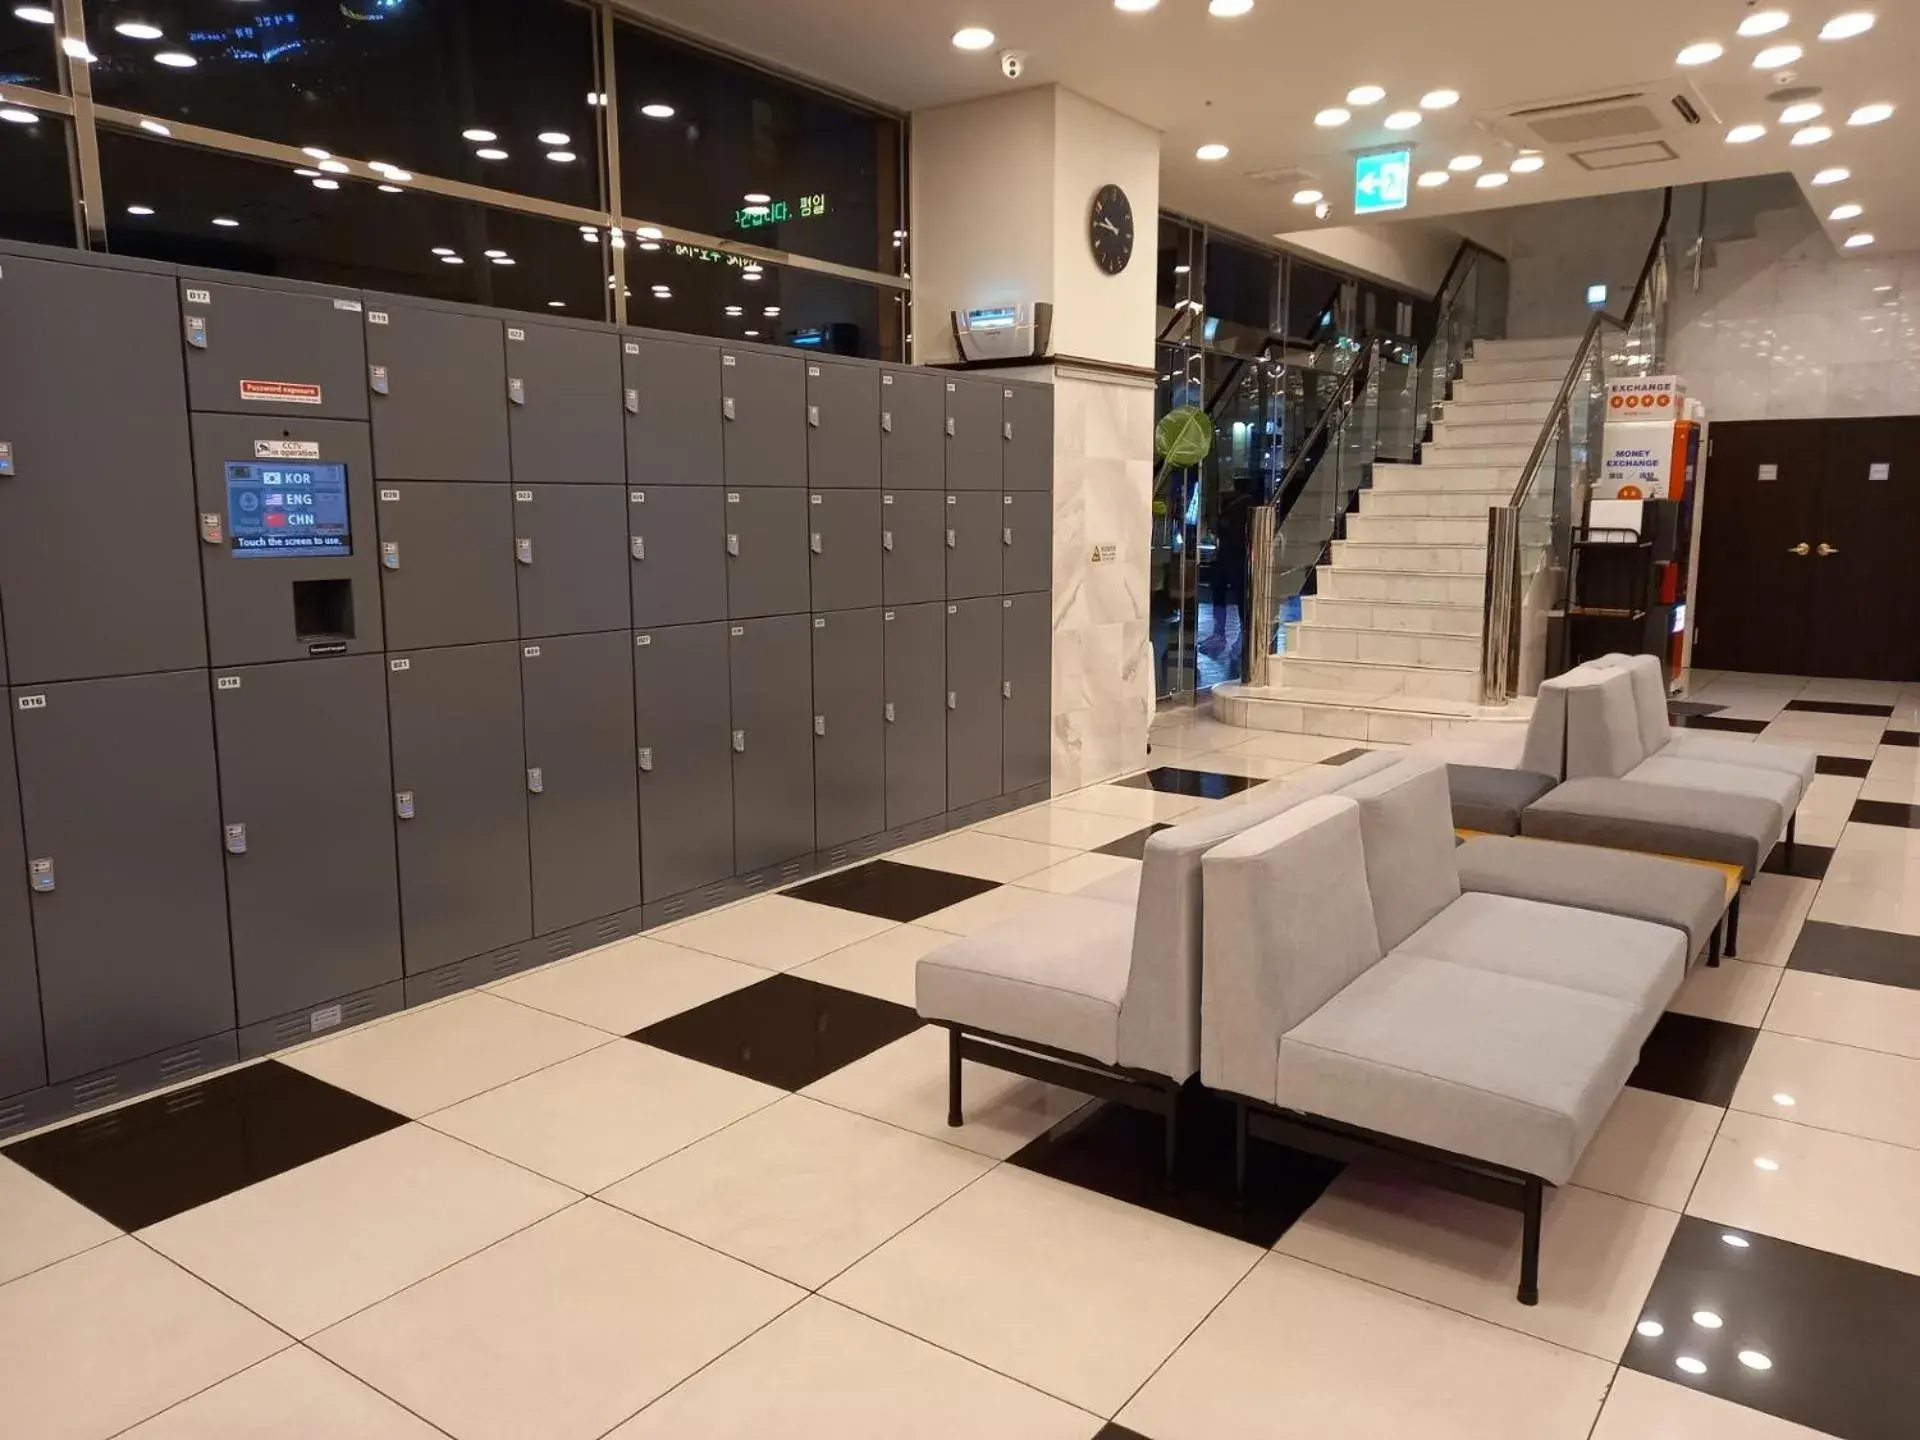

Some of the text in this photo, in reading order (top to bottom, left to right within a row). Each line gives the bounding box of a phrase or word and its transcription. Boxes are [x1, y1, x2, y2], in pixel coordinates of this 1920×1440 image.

[800, 194, 825, 216] 평일
[189, 290, 208, 300] 017
[1611, 383, 1672, 393] EXCHANGE
[1616, 450, 1650, 458] MONEY
[1607, 460, 1659, 468] EXCHANGE
[285, 473, 311, 485] KOR
[286, 494, 313, 506] ENG
[288, 514, 315, 526] CHN
[238, 537, 267, 547] Touch
[268, 537, 283, 547] the
[284, 537, 312, 546] screen
[314, 537, 323, 546] to
[219, 677, 239, 688] 018
[21, 696, 44, 707] 016
